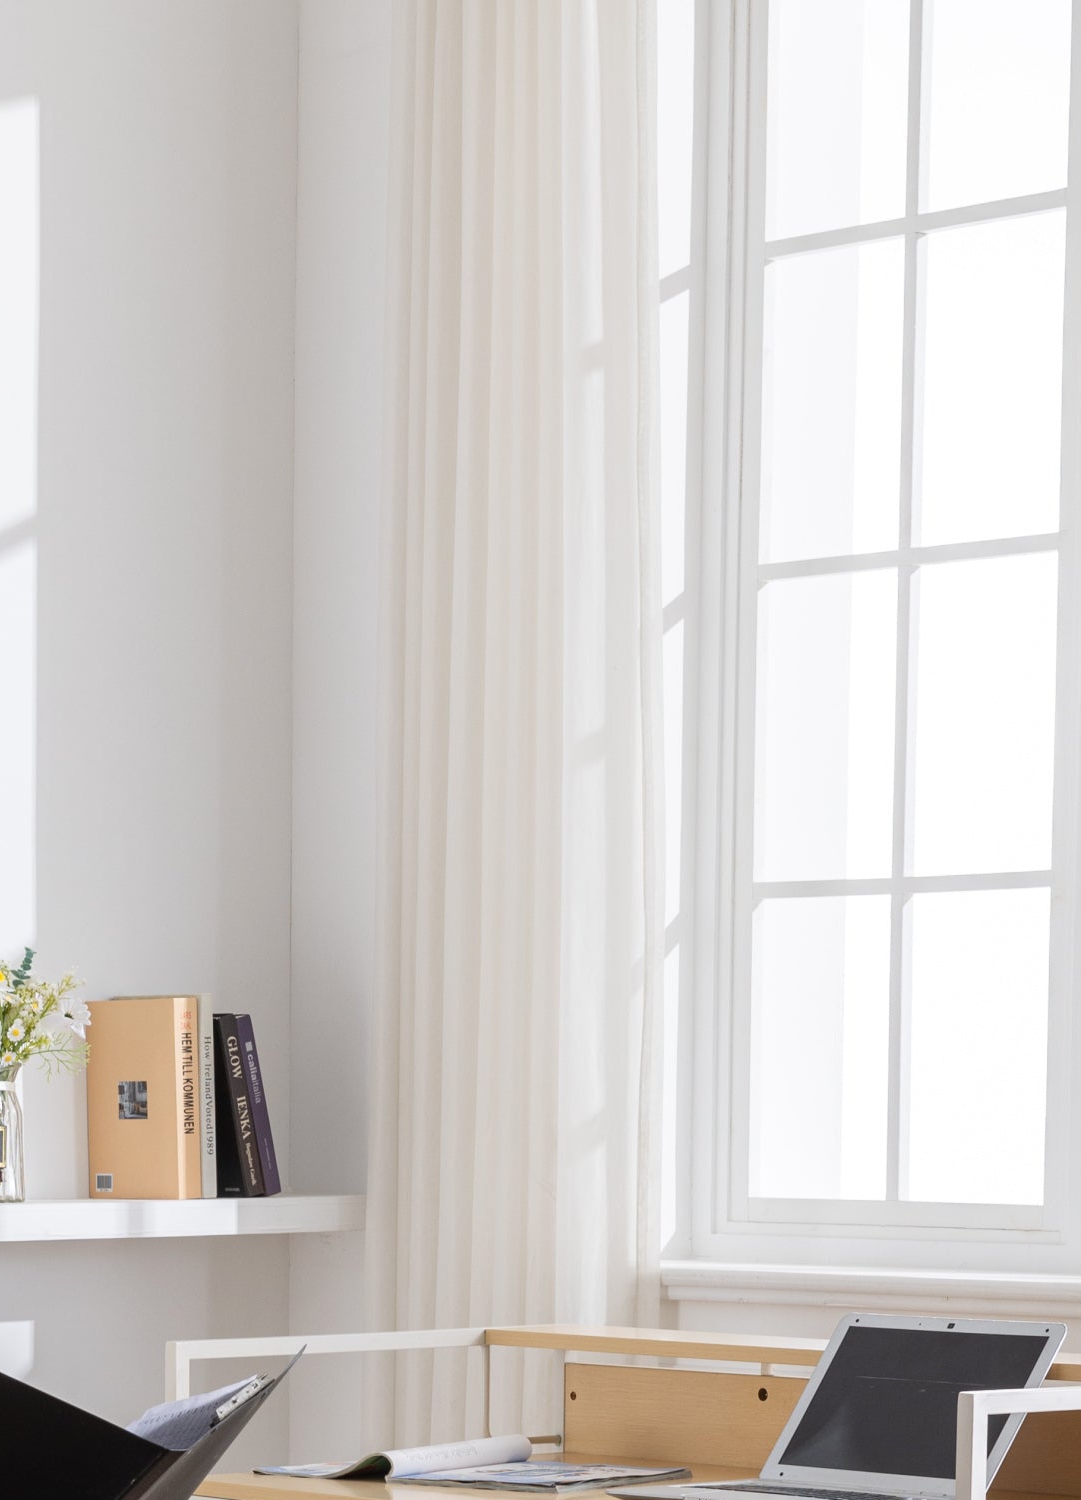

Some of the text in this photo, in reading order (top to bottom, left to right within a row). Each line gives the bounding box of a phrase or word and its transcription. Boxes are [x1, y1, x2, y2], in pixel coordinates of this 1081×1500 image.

[181, 1032, 192, 1053] HEM
[203, 1036, 212, 1059] How
[182, 1056, 193, 1076] TILL
[183, 1078, 195, 1135] KOMMUNEN
[236, 1096, 251, 1140] IENKA
